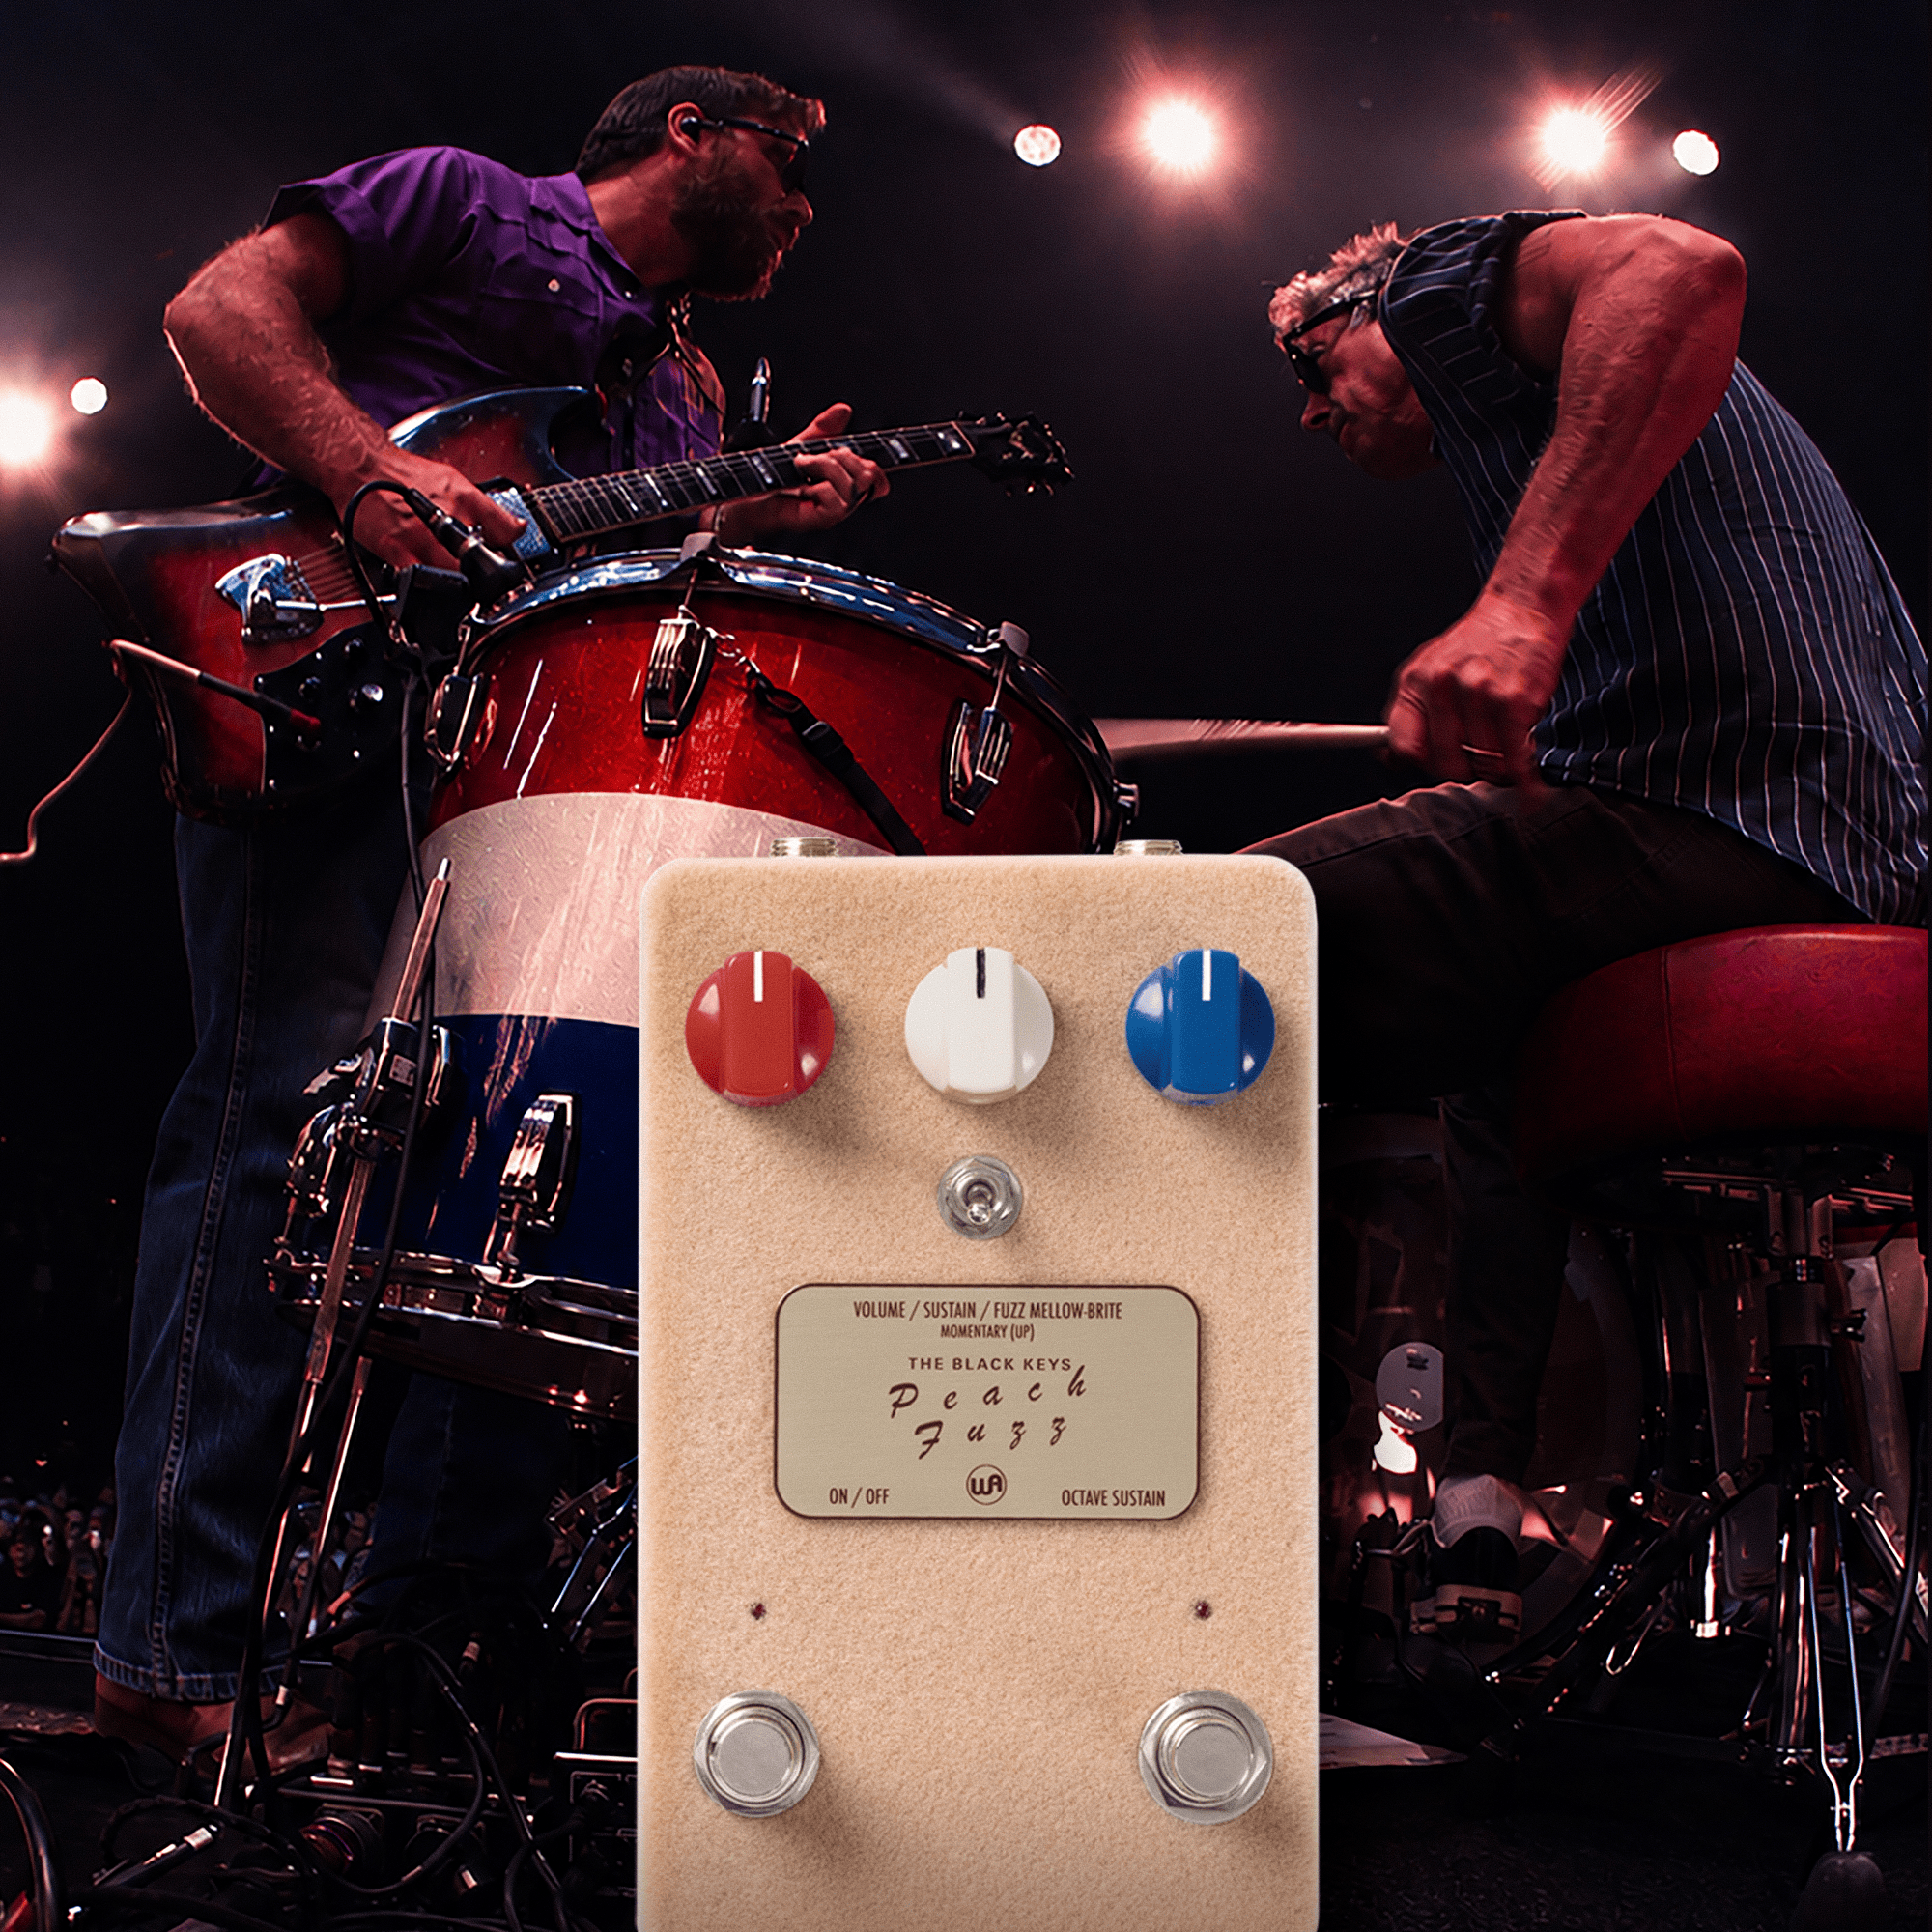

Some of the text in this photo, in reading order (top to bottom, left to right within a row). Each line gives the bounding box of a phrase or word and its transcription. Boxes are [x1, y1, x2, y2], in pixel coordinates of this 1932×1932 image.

[853, 1301, 906, 1320] VOLUME
[923, 1302, 977, 1320] SUSTAIN
[994, 1301, 1026, 1320] FUZZ
[1030, 1301, 1122, 1320] MELLOW-BRITE
[940, 1324, 1035, 1342] MOMENTARY (UP)
[908, 1357, 1072, 1372] THE BLACK KEYS
[889, 1365, 1087, 1419] Peach
[914, 1417, 1067, 1460] Fuzz
[829, 1488, 848, 1505] ON
[866, 1488, 890, 1505] OFF
[1061, 1489, 1166, 1507] OCTAVE SUSTAIN
